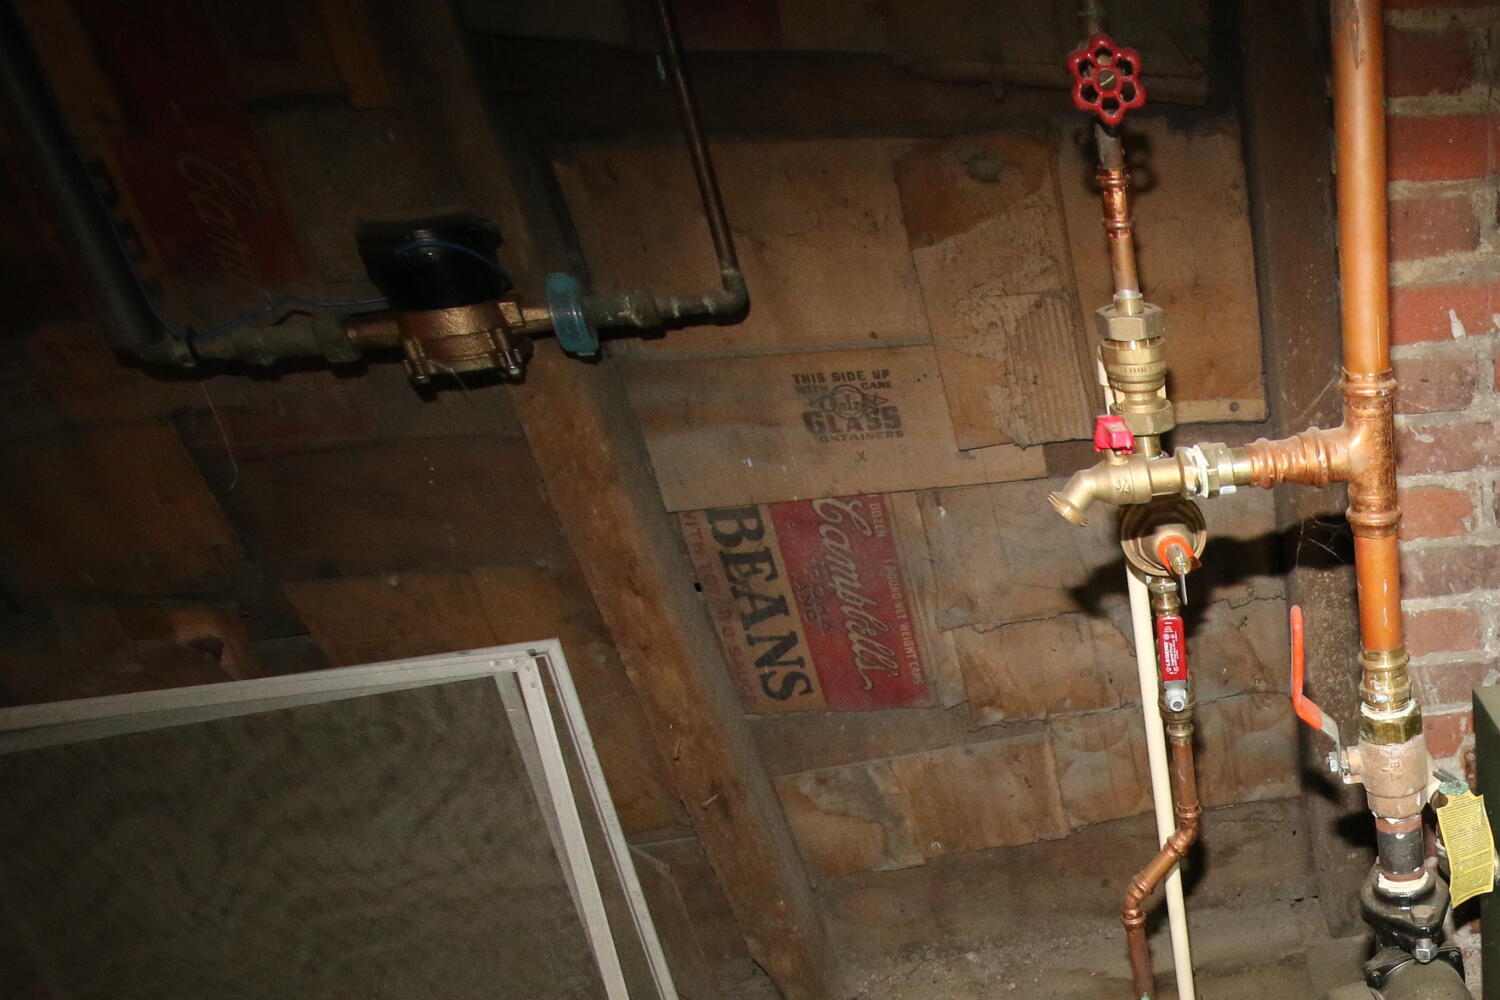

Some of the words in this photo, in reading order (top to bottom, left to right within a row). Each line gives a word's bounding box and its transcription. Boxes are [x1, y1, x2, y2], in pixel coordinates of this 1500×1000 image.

[791, 373, 826, 385] THIS
[831, 369, 866, 382] SIDE
[872, 369, 890, 380] UP
[861, 381, 893, 390] CARE
[802, 406, 902, 434] GLASS
[816, 431, 904, 442] ONTAINERS
[705, 505, 814, 700] BEANS
